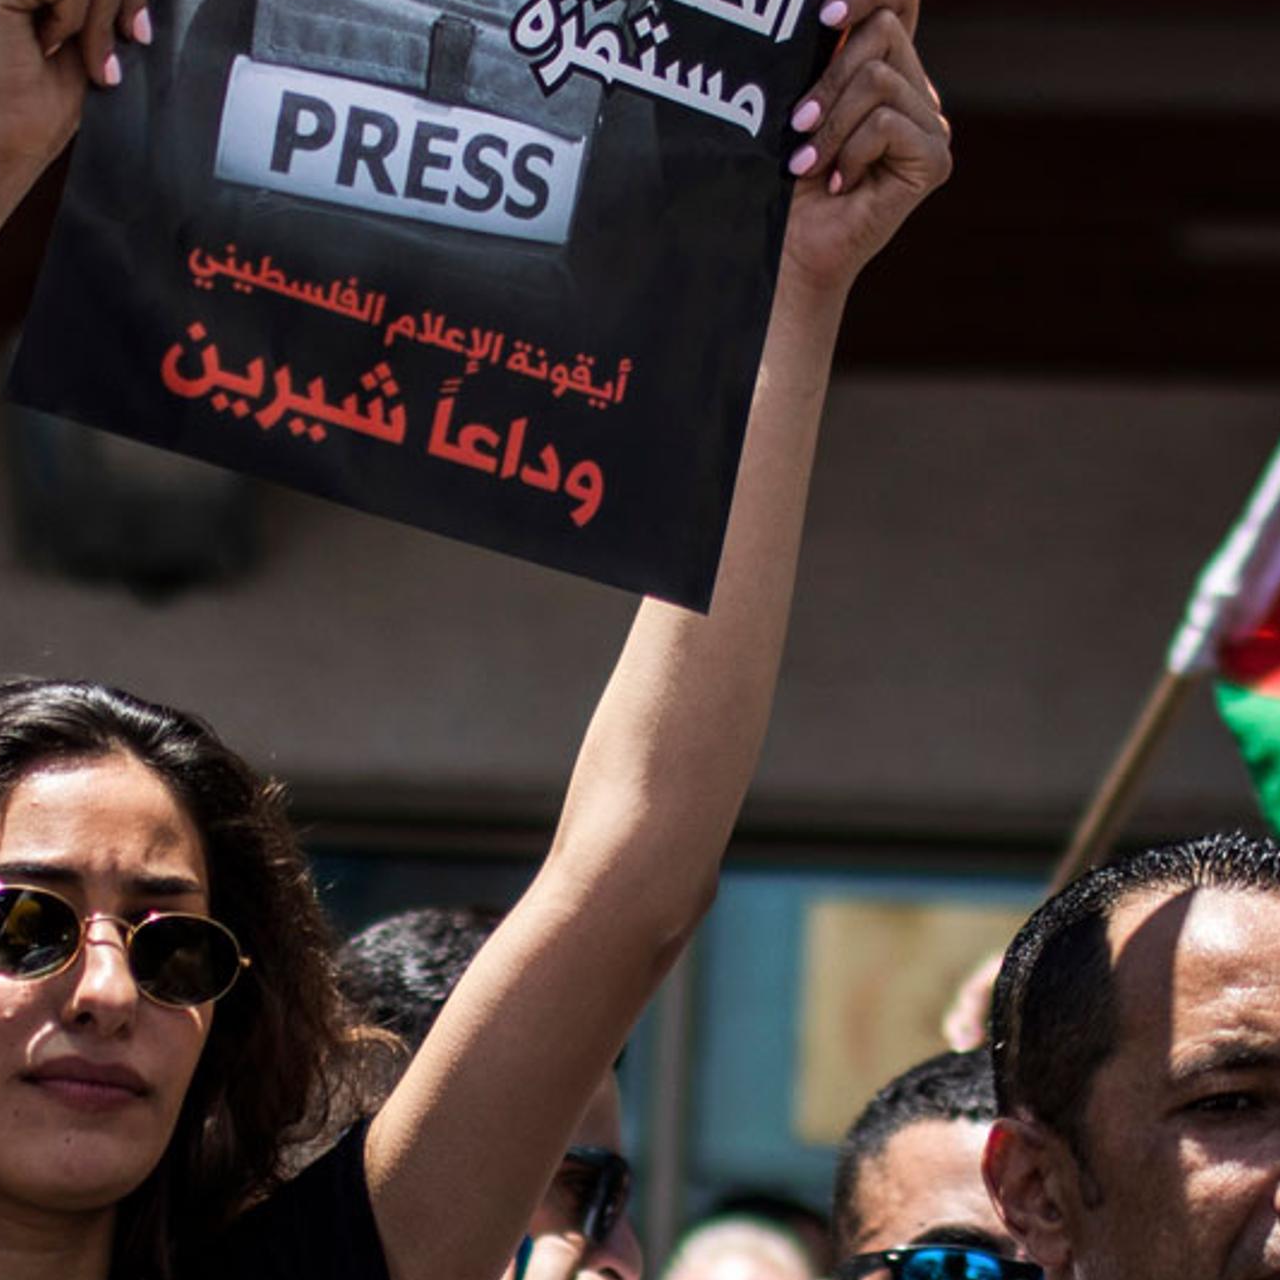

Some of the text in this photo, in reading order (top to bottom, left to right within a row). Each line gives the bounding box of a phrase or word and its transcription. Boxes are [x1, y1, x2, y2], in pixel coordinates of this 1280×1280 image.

[270, 90, 555, 220] PRESS
[187, 243, 634, 410] أيقونة الإعلام الفلسطيني
[160, 321, 605, 527] وداعاً شيرين
